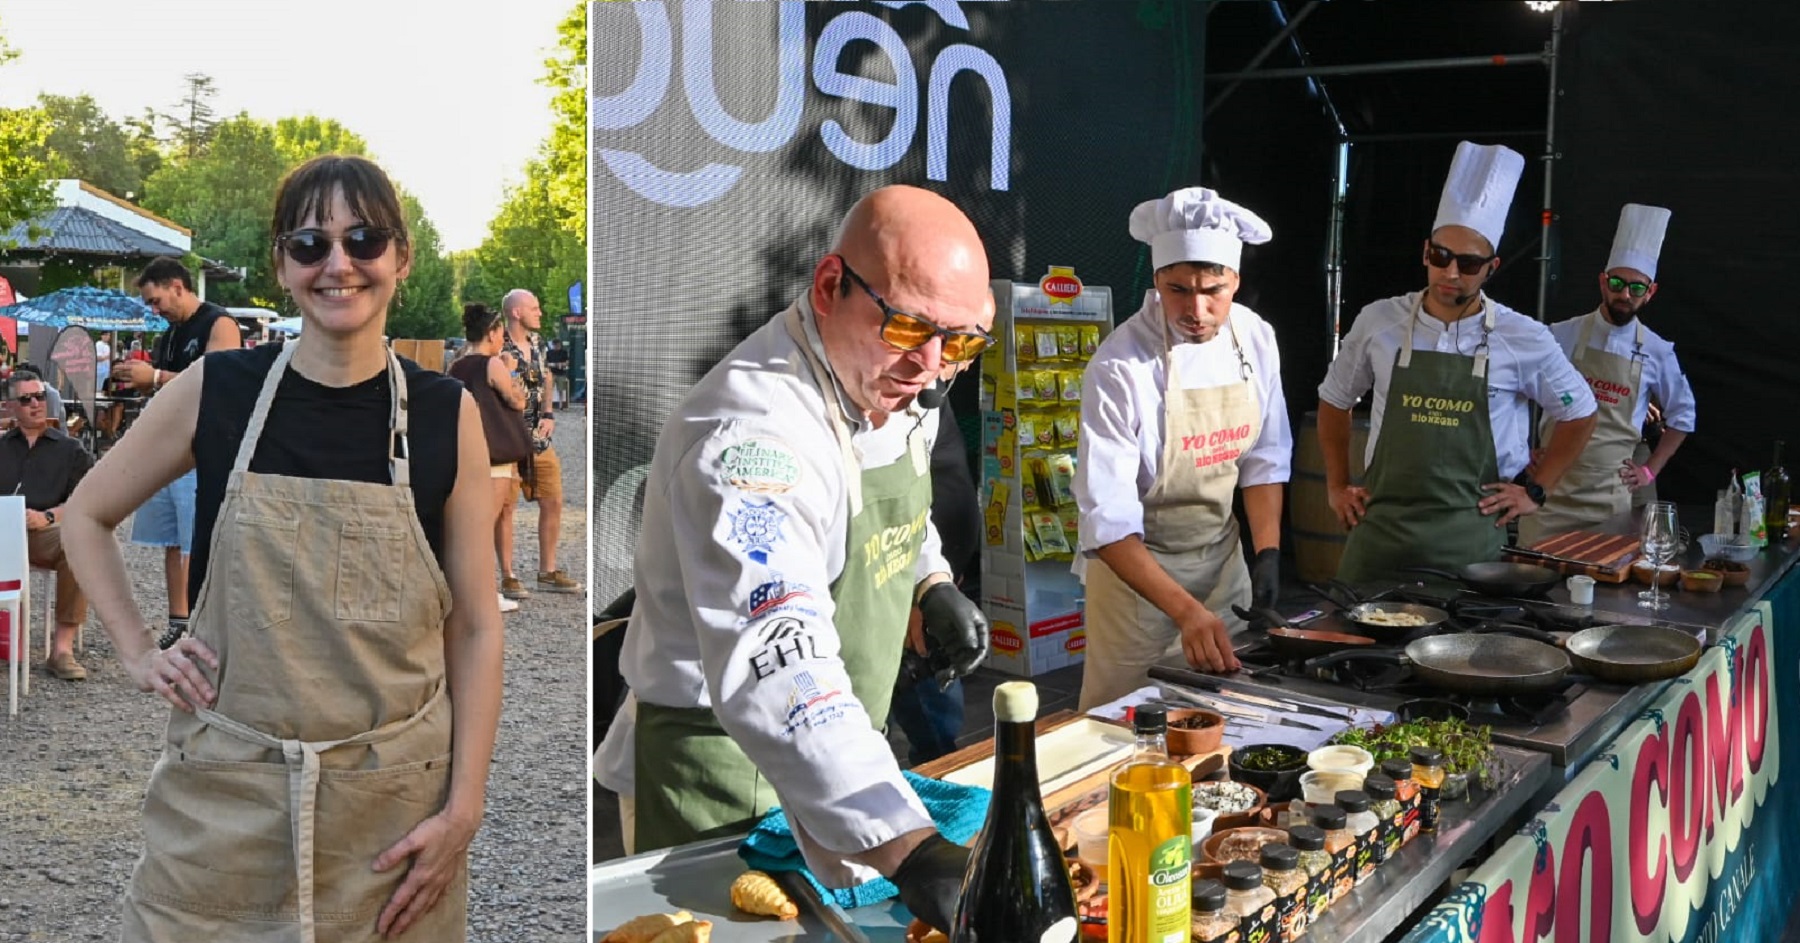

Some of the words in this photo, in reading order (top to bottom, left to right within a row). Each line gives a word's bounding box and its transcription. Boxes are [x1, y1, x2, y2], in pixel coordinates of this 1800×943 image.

[1402, 394, 1423, 408] YO
[1424, 397, 1475, 413] COMO
[1594, 379, 1631, 397] COMO
[1428, 416, 1460, 427] NEGRO
[1182, 434, 1206, 451] YO
[1209, 424, 1251, 447] COMO
[864, 533, 880, 569] YO
[749, 635, 828, 681] EHL
[1629, 625, 1768, 936] COMO
[1719, 843, 1756, 931] CANALE
